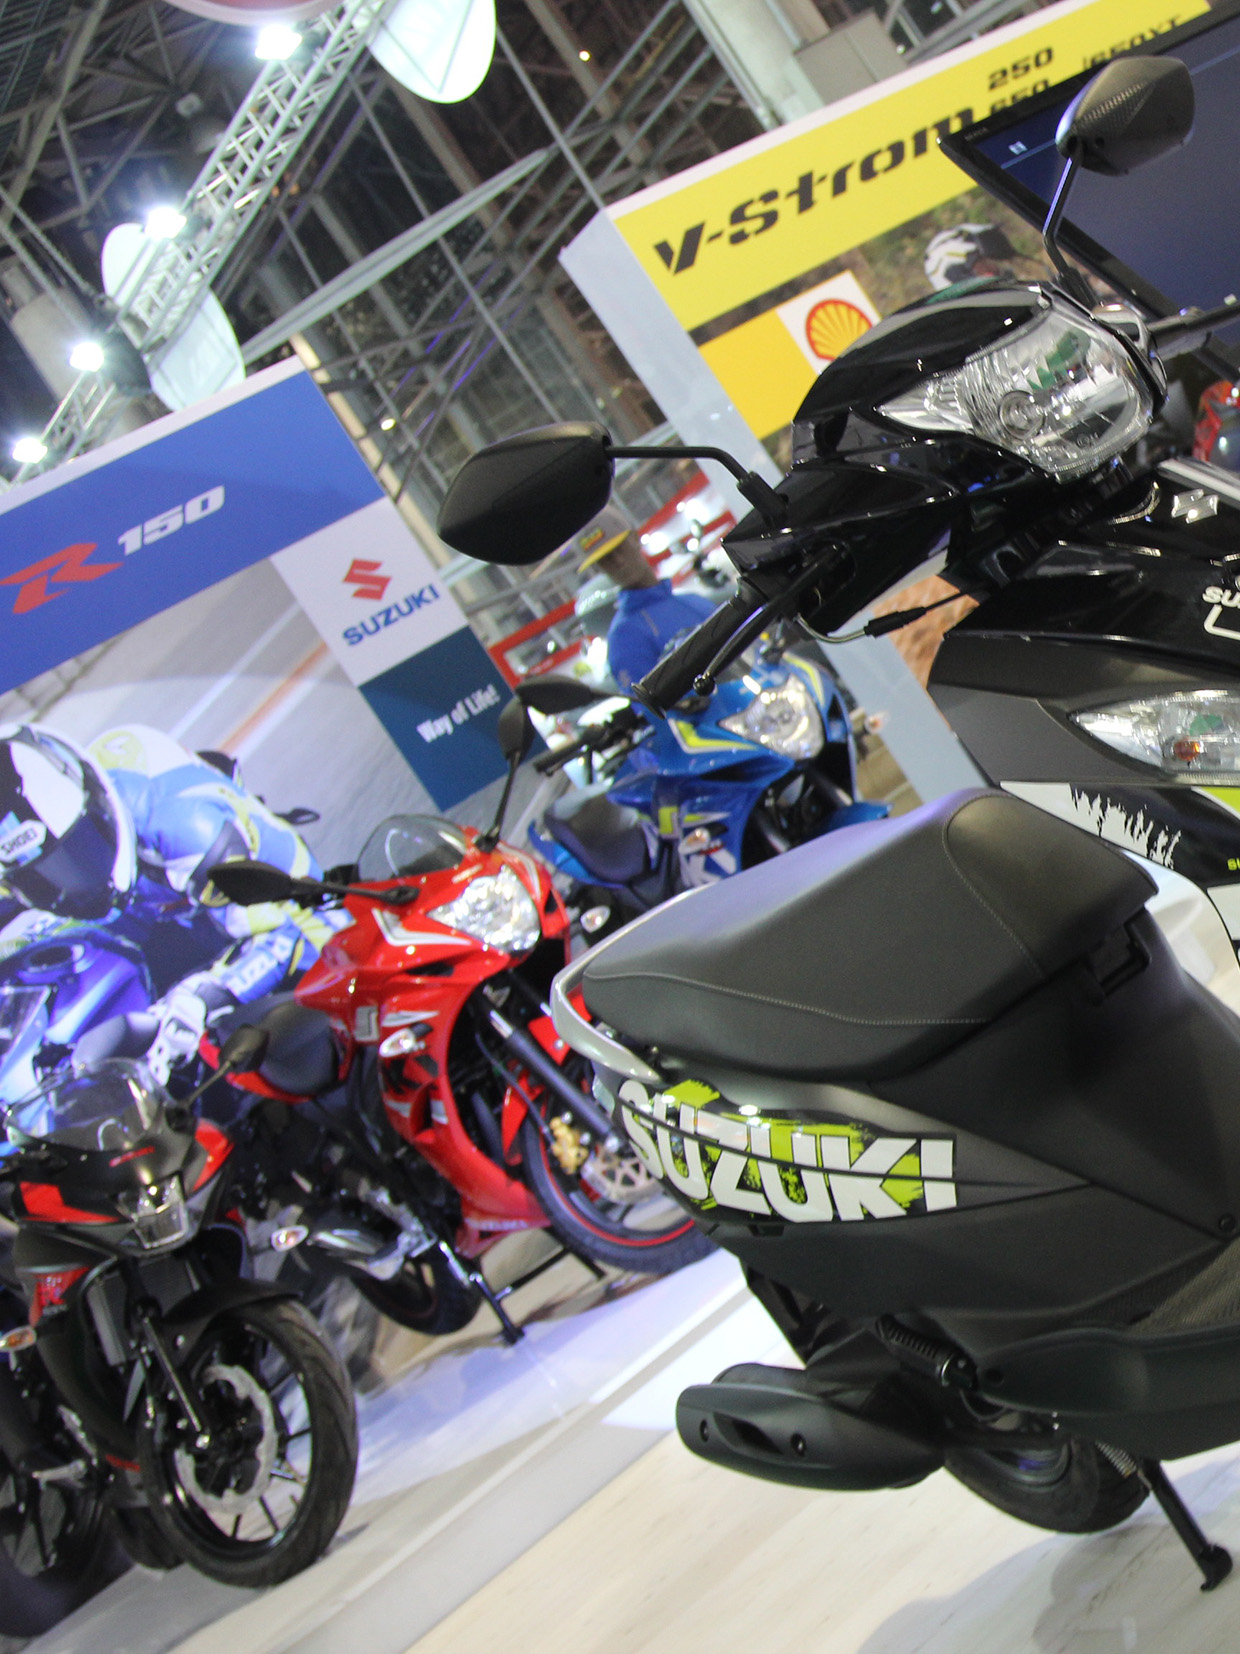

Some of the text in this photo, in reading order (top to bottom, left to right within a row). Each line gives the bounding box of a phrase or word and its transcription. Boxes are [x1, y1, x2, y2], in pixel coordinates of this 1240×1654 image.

[988, 47, 1053, 91] 250
[654, 106, 975, 275] V-Strom
[118, 485, 225, 556] 150
[342, 583, 440, 646] SUZUKI
[416, 684, 500, 743] Way of Life!
[618, 1079, 957, 1223] SUZUKI
